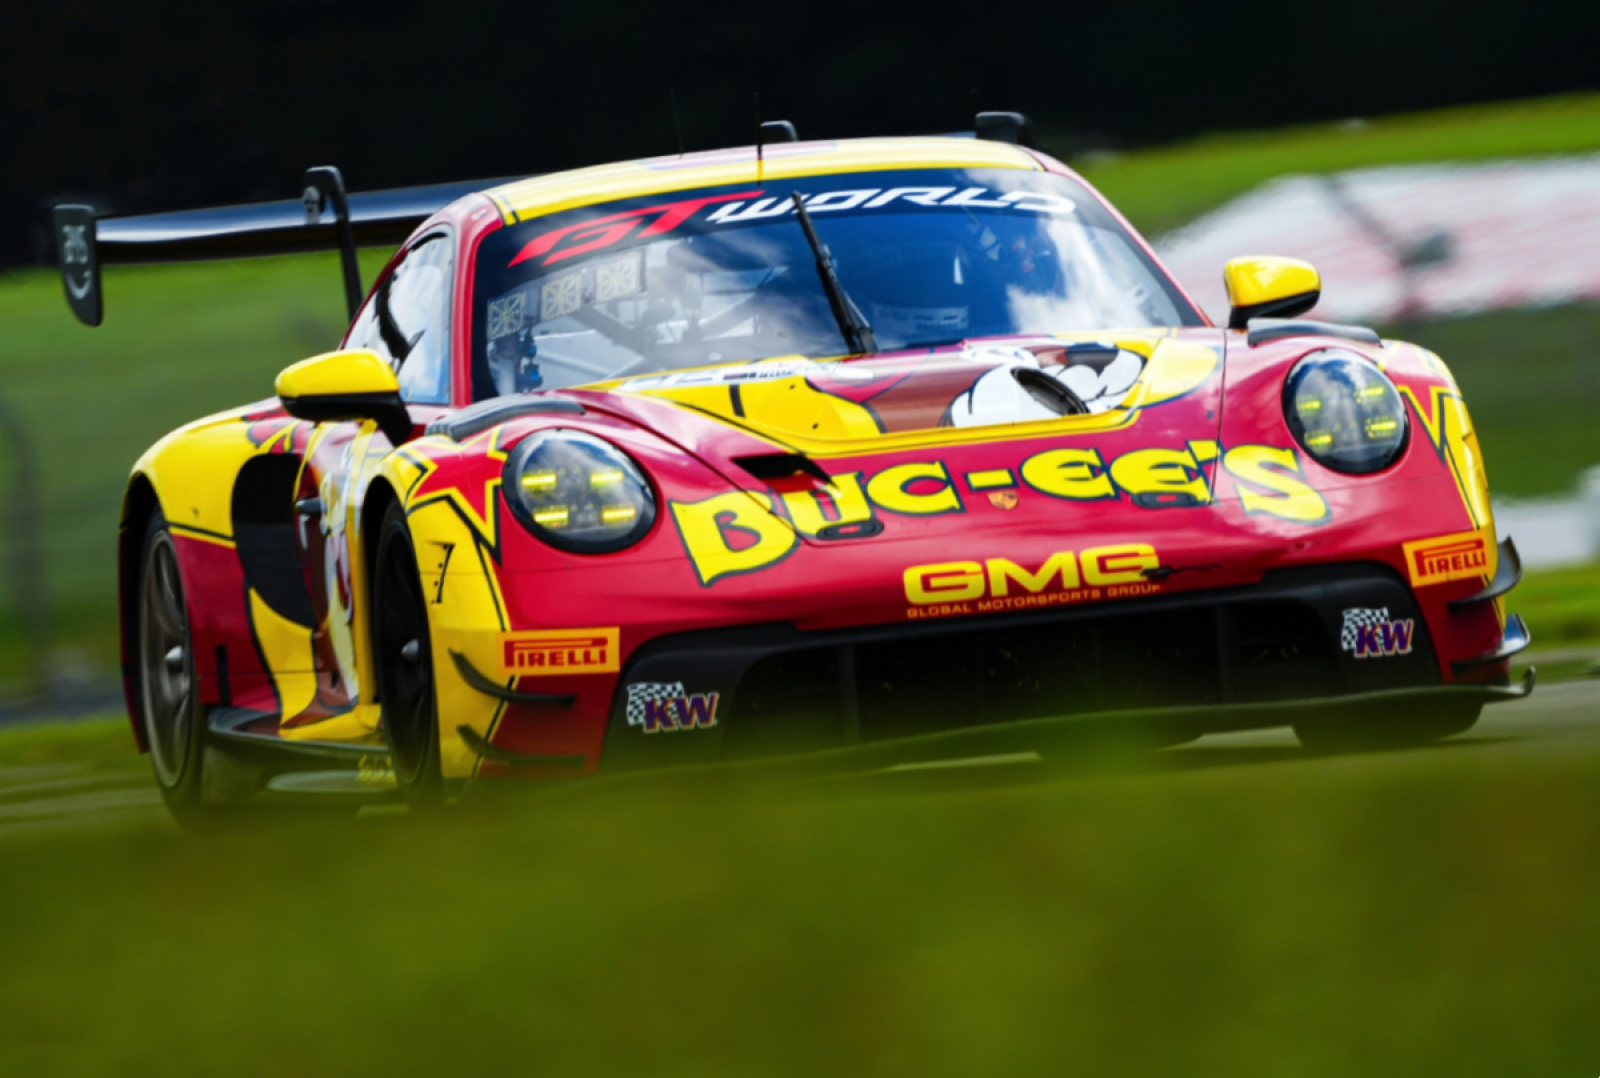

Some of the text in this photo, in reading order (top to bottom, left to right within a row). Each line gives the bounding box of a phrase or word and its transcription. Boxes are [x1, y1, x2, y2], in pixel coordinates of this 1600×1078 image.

[507, 187, 1076, 268] GT WORLD
[903, 543, 1160, 605] GMG
[1413, 539, 1486, 577] PIRELLI
[907, 584, 1162, 619] GLOBAL MOTORSPORTS GROUP
[504, 637, 608, 668] PIRELLI
[1354, 618, 1414, 658] KW
[643, 692, 719, 733] KW
